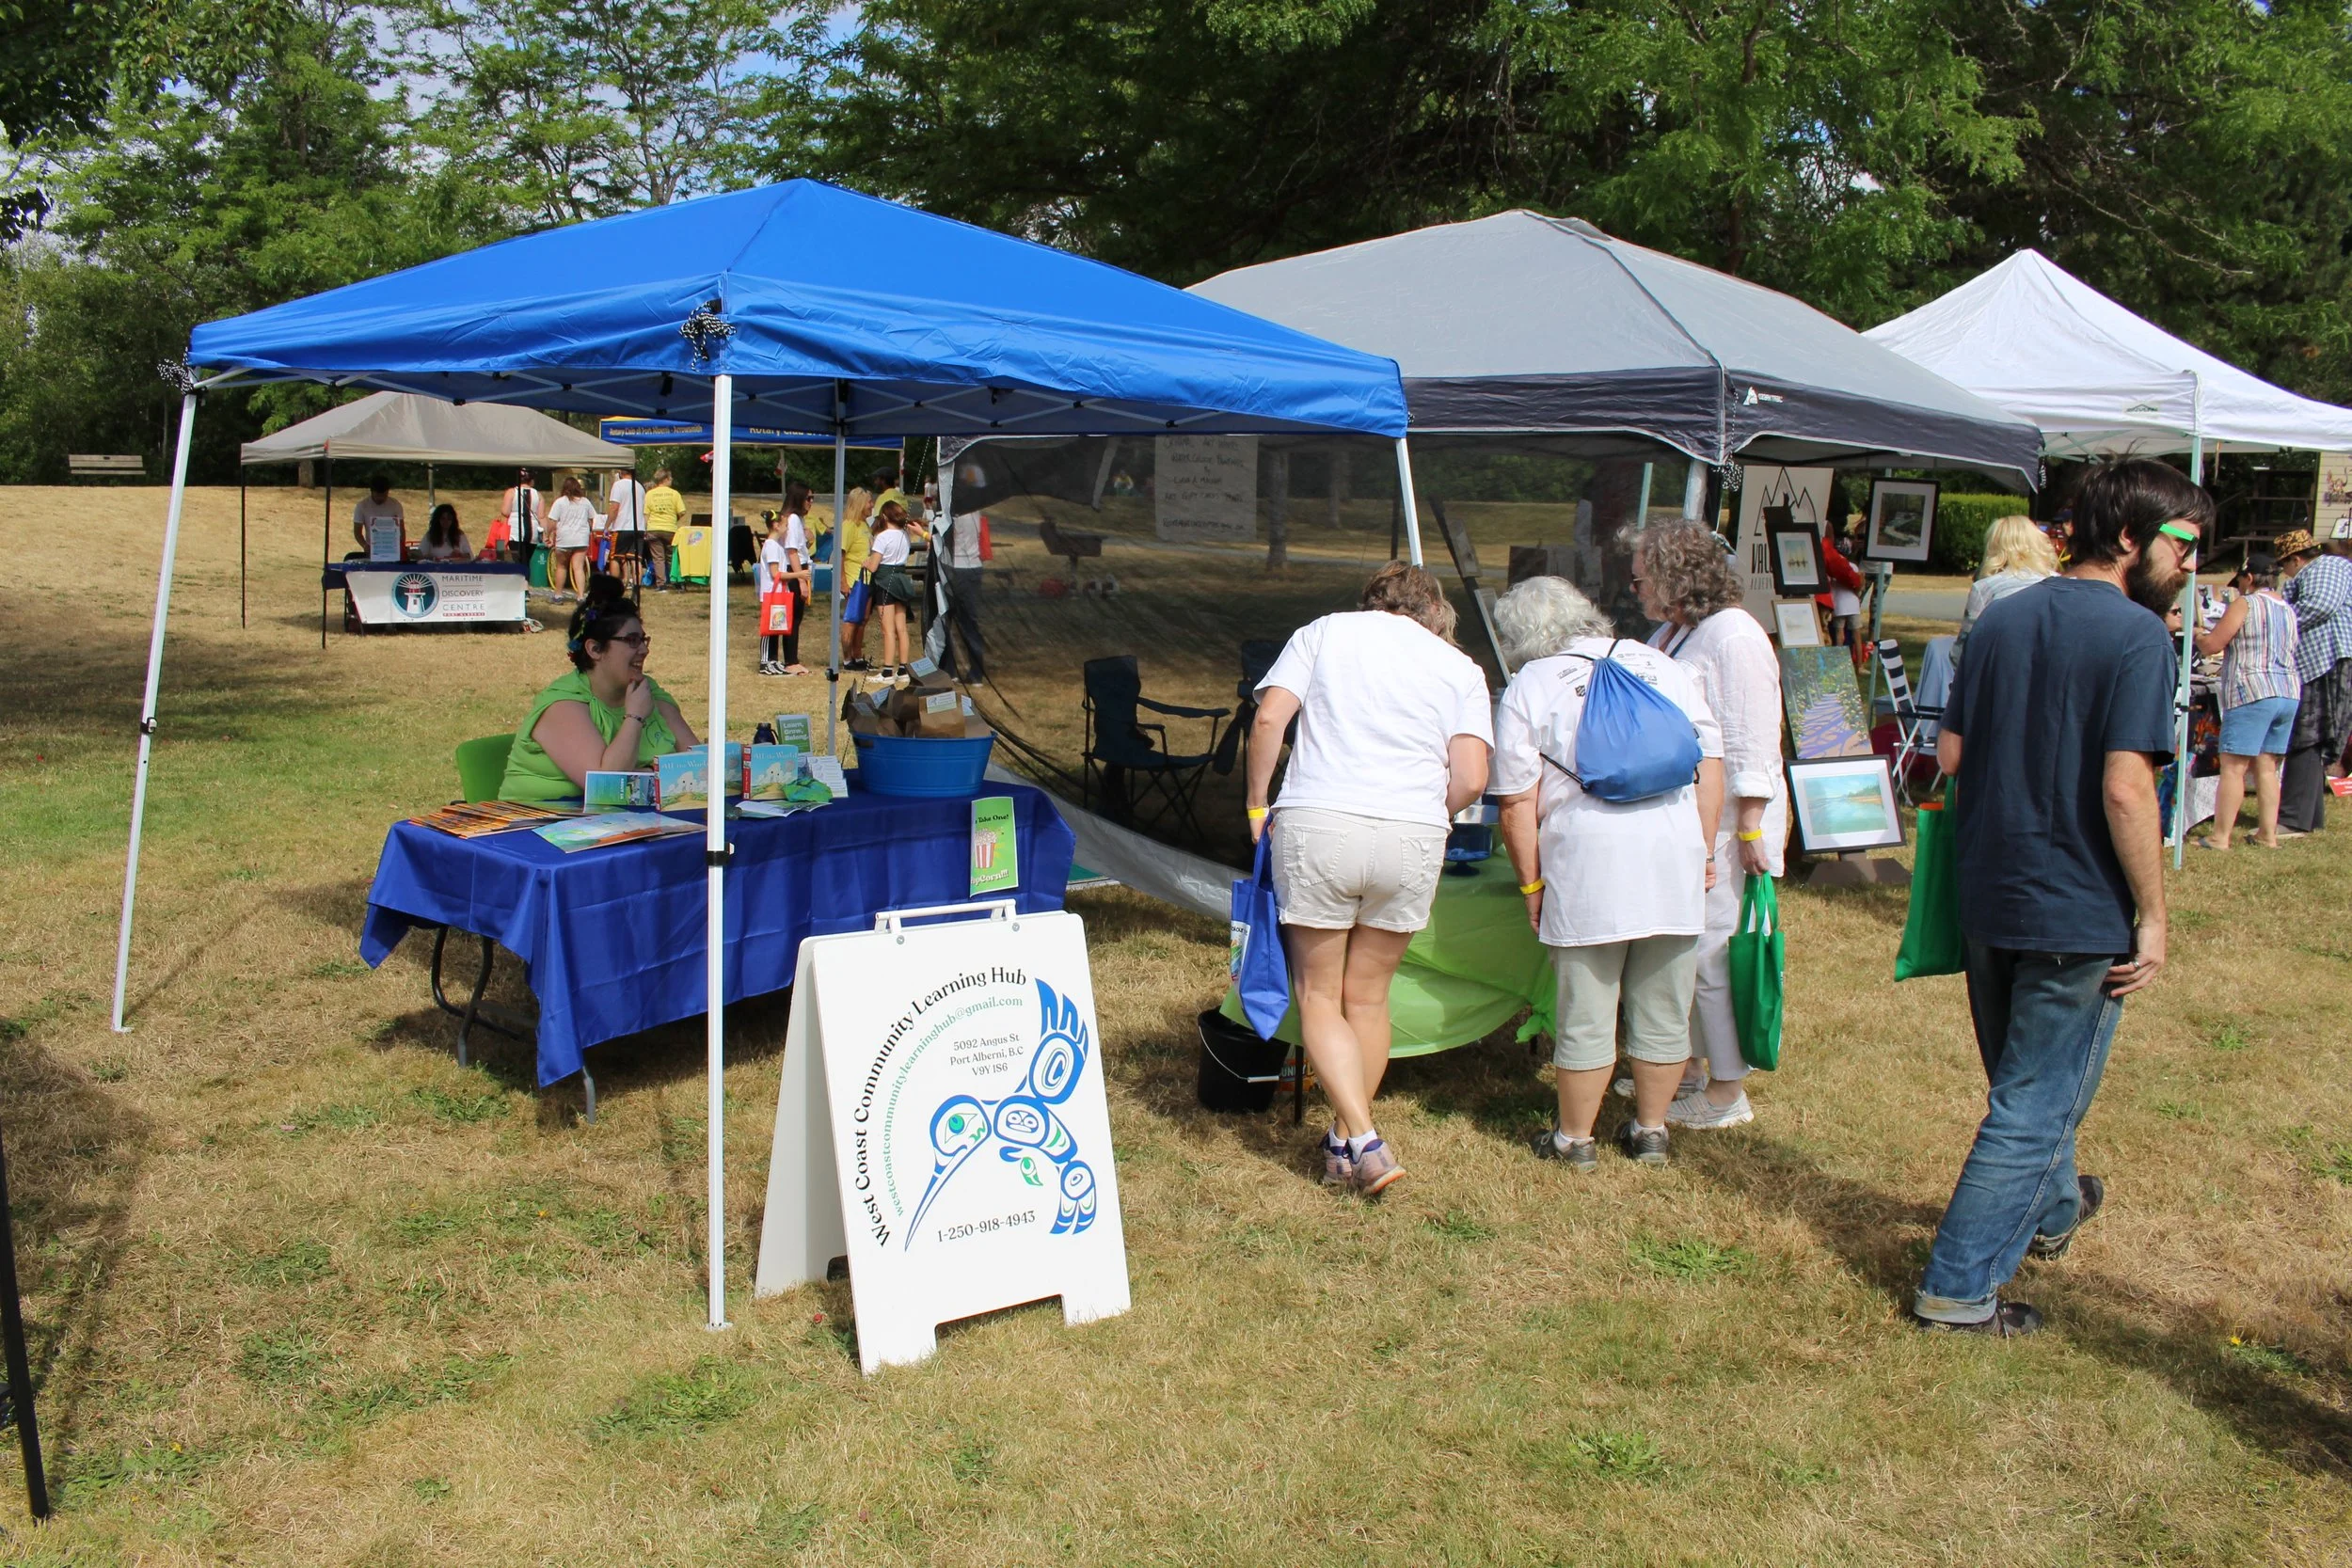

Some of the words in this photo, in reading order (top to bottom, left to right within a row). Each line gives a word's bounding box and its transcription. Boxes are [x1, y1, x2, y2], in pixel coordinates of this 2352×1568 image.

[775, 751, 798, 759] World
[991, 966, 1027, 987] Hub
[911, 972, 987, 1016] Learning
[949, 1054, 971, 1066] Port
[972, 1049, 1008, 1063] Alberni,
[1009, 1046, 1025, 1058] B.C
[953, 1038, 978, 1052] 5092
[980, 1036, 1008, 1047] Angus
[1009, 1033, 1020, 1042] St
[853, 1010, 914, 1122] Community
[972, 1066, 991, 1076] V9Y
[882, 995, 1024, 1217] westcoastcommunitylearninghub@gmail.com
[854, 1129, 870, 1191] Coast
[863, 1195, 890, 1248] West
[938, 1210, 1036, 1243] 1-250-918-4943
